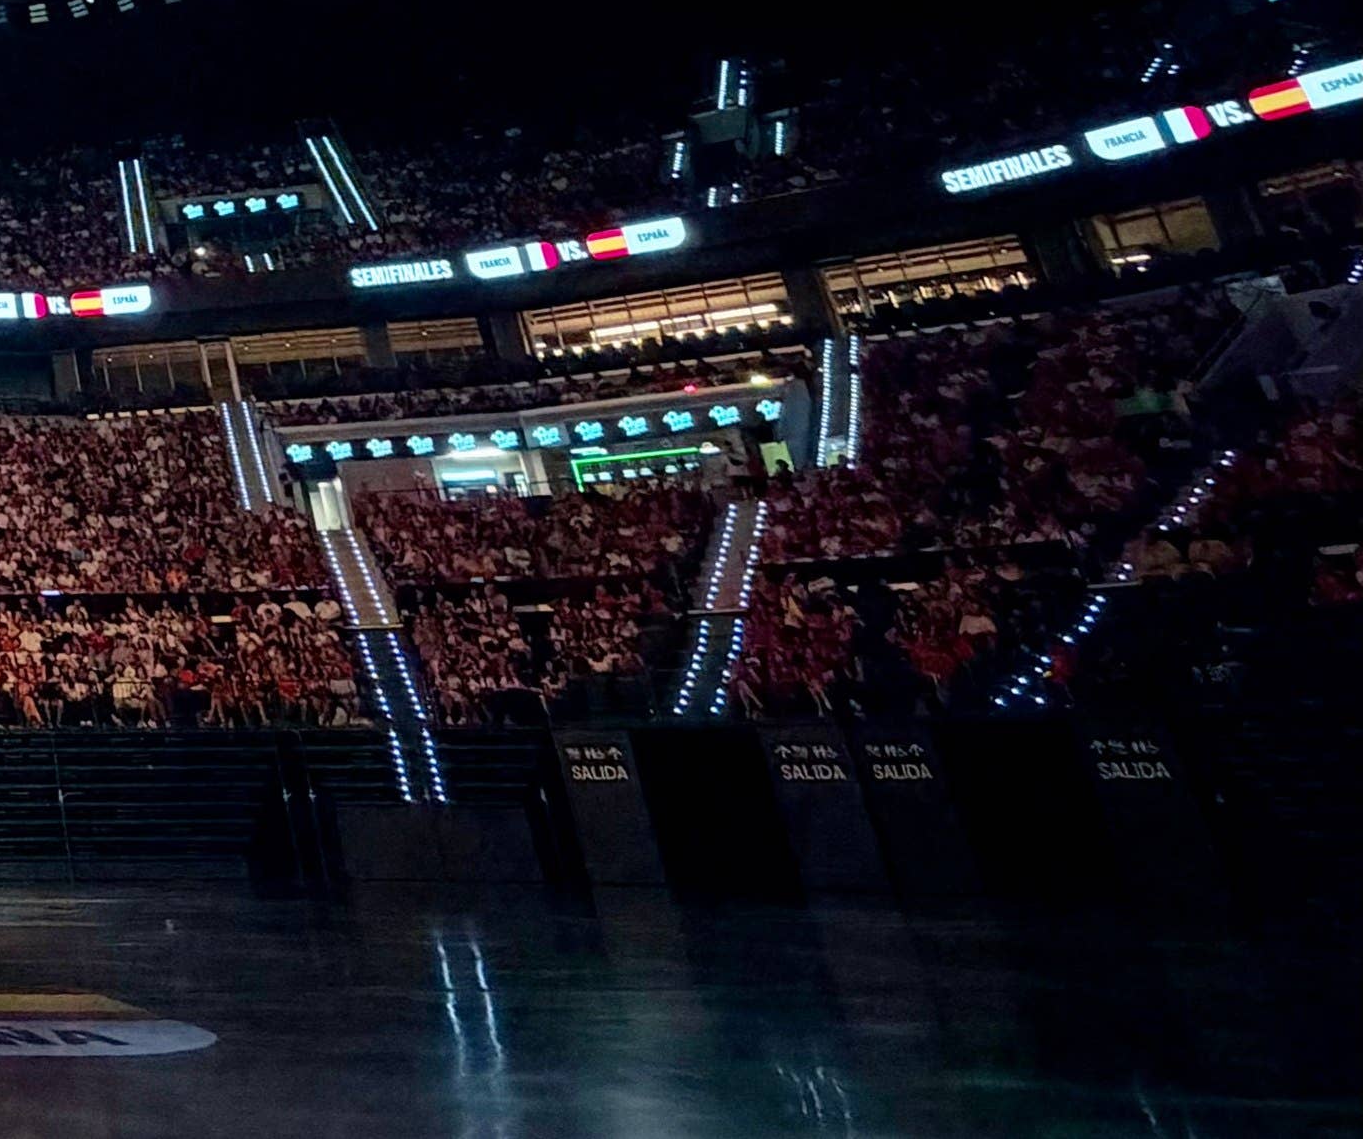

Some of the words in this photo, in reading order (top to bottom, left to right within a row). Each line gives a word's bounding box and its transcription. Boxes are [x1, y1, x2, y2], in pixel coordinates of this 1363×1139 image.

[940, 144, 1074, 195] SEMIFINALES
[1206, 99, 1255, 128] VS.
[350, 259, 453, 288] SEMIFINALES
[556, 241, 588, 261] VS.
[45, 296, 71, 315] VS.
[571, 764, 628, 781] SALIDA
[780, 764, 846, 781] SALIDA
[873, 762, 933, 780] SALIDA
[1095, 761, 1174, 780] SALIDA
